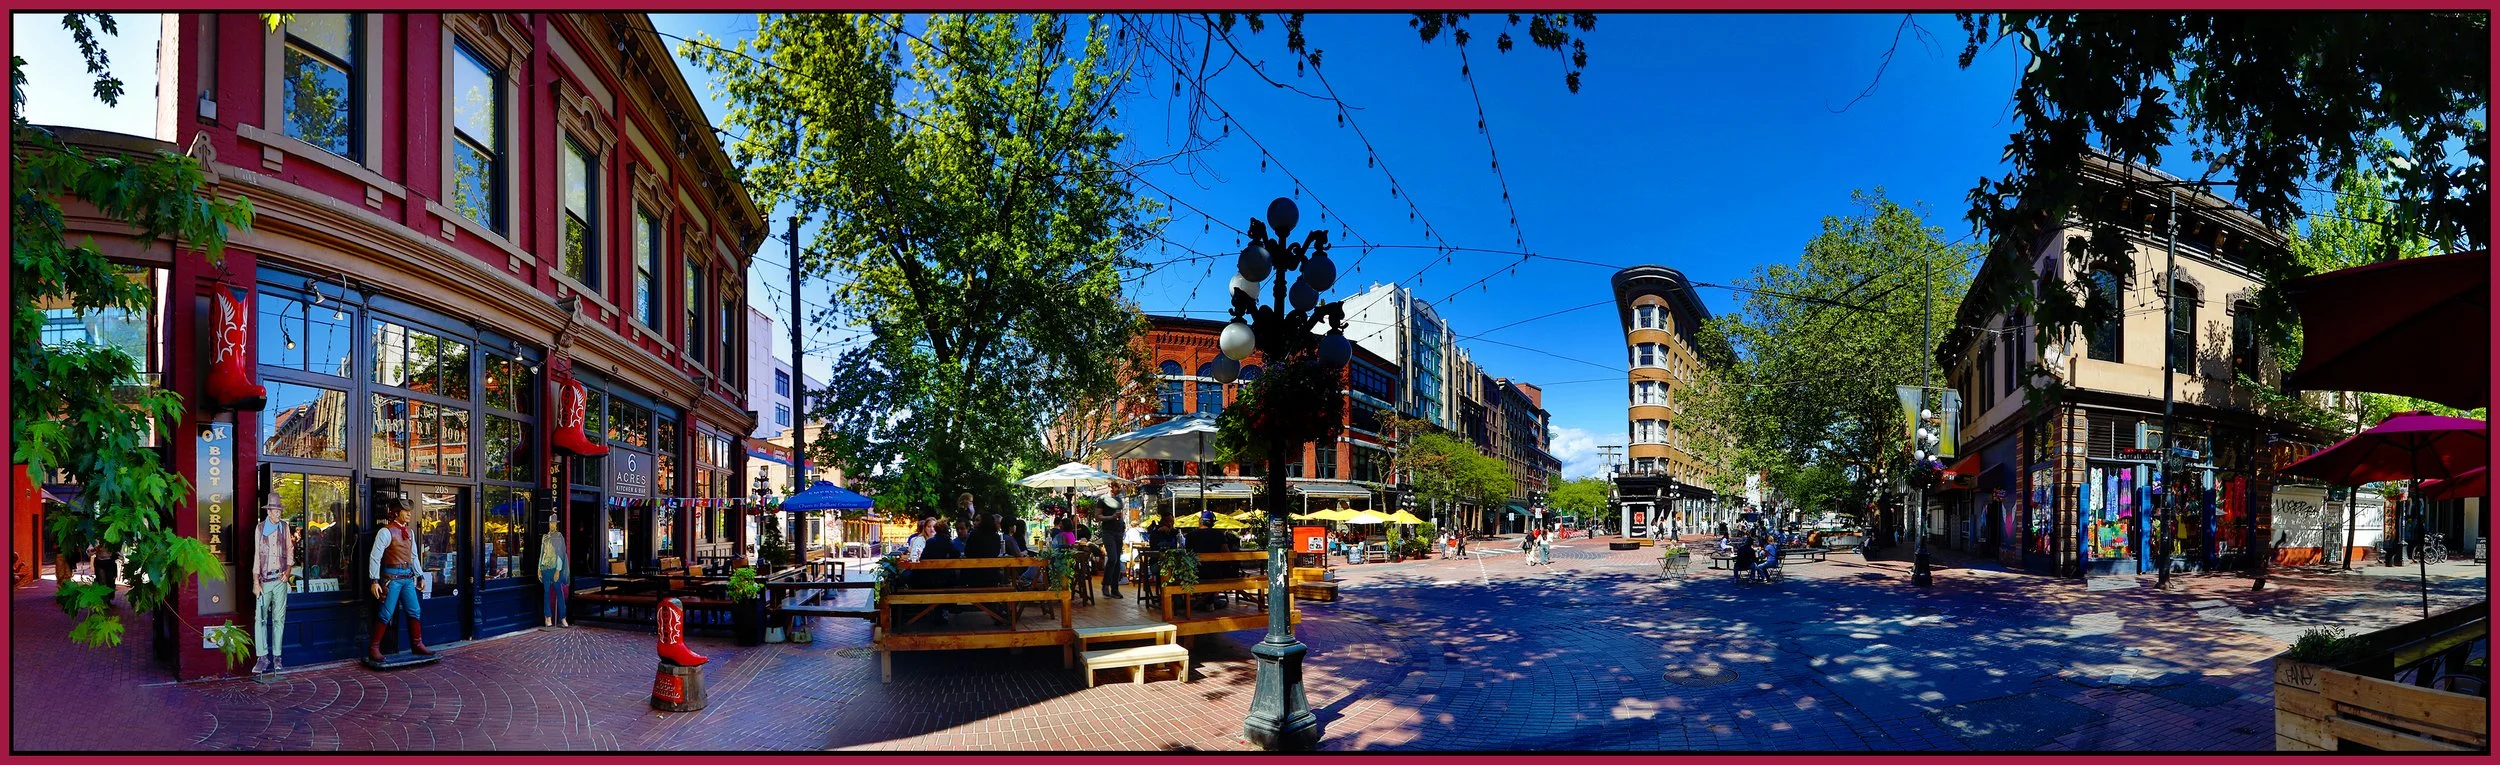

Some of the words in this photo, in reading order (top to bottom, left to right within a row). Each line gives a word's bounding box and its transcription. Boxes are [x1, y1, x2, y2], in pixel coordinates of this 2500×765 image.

[374, 418, 431, 435] WESTERN
[202, 427, 227, 442] OK
[209, 446, 221, 486] BOOT
[550, 465, 560, 475] OK
[627, 453, 637, 472] 6
[616, 472, 646, 485] ACRES
[435, 486, 449, 494] 205
[616, 485, 634, 493] KITCHEN
[209, 493, 221, 554] CORRAL
